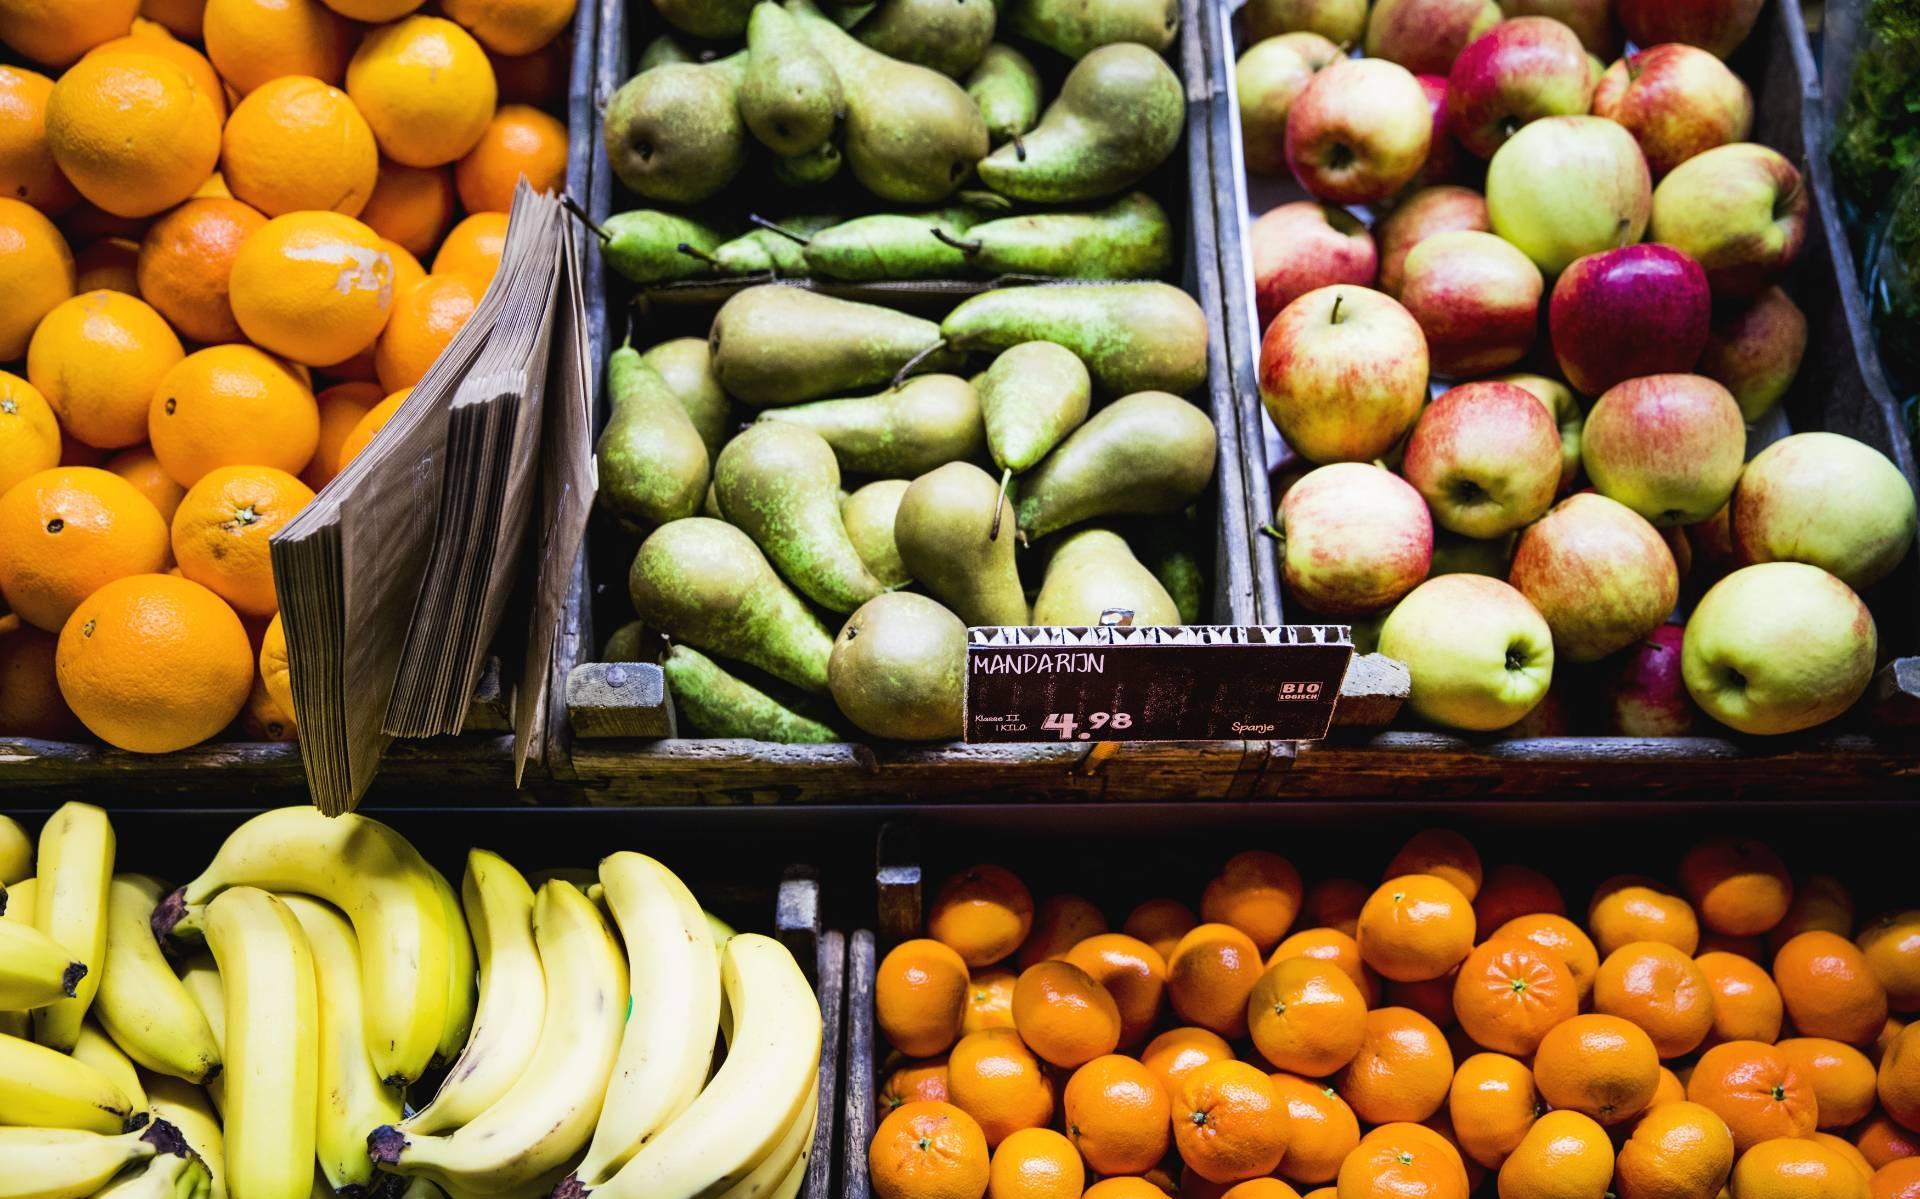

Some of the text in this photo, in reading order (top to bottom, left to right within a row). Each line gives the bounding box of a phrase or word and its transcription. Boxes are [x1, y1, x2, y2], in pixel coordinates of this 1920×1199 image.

[974, 653, 1105, 674] MANDARIJN
[1282, 683, 1320, 694] BIO
[975, 714, 1020, 722] Klasse II
[1041, 711, 1133, 740] 4.98
[1231, 721, 1275, 734] Spanje
